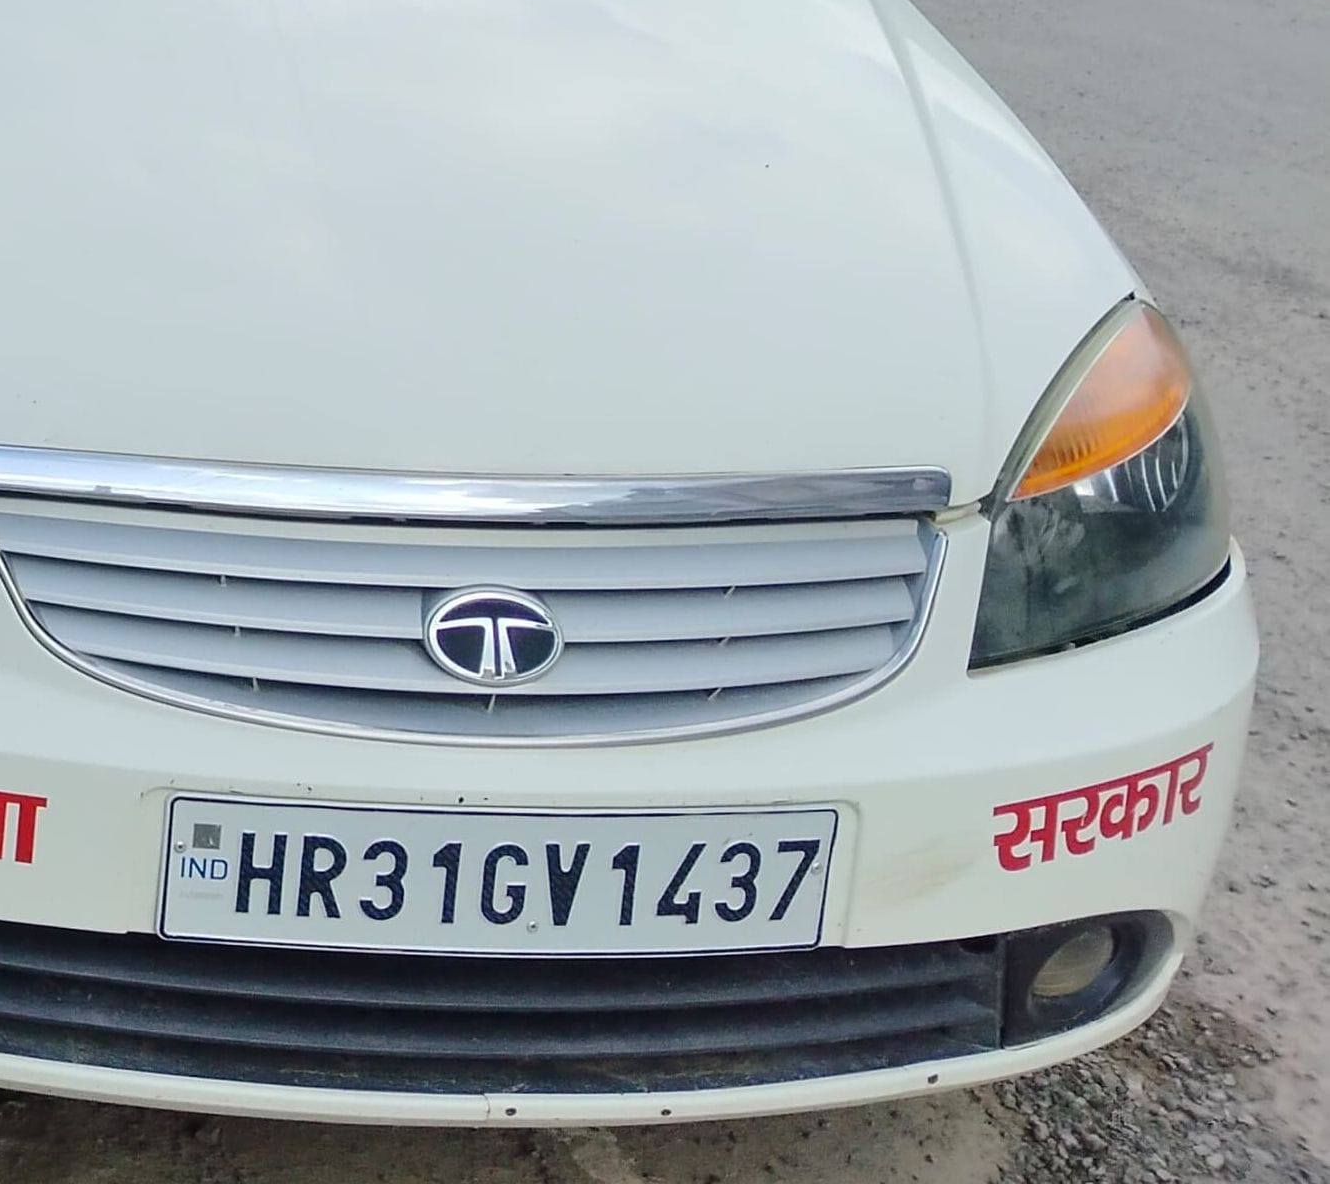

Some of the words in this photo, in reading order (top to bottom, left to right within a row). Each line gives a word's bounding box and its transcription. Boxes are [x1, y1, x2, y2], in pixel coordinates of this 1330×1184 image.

[993, 741, 1214, 872] सरकार
[179, 856, 228, 881] IND
[235, 831, 821, 927] HR31GV1437
